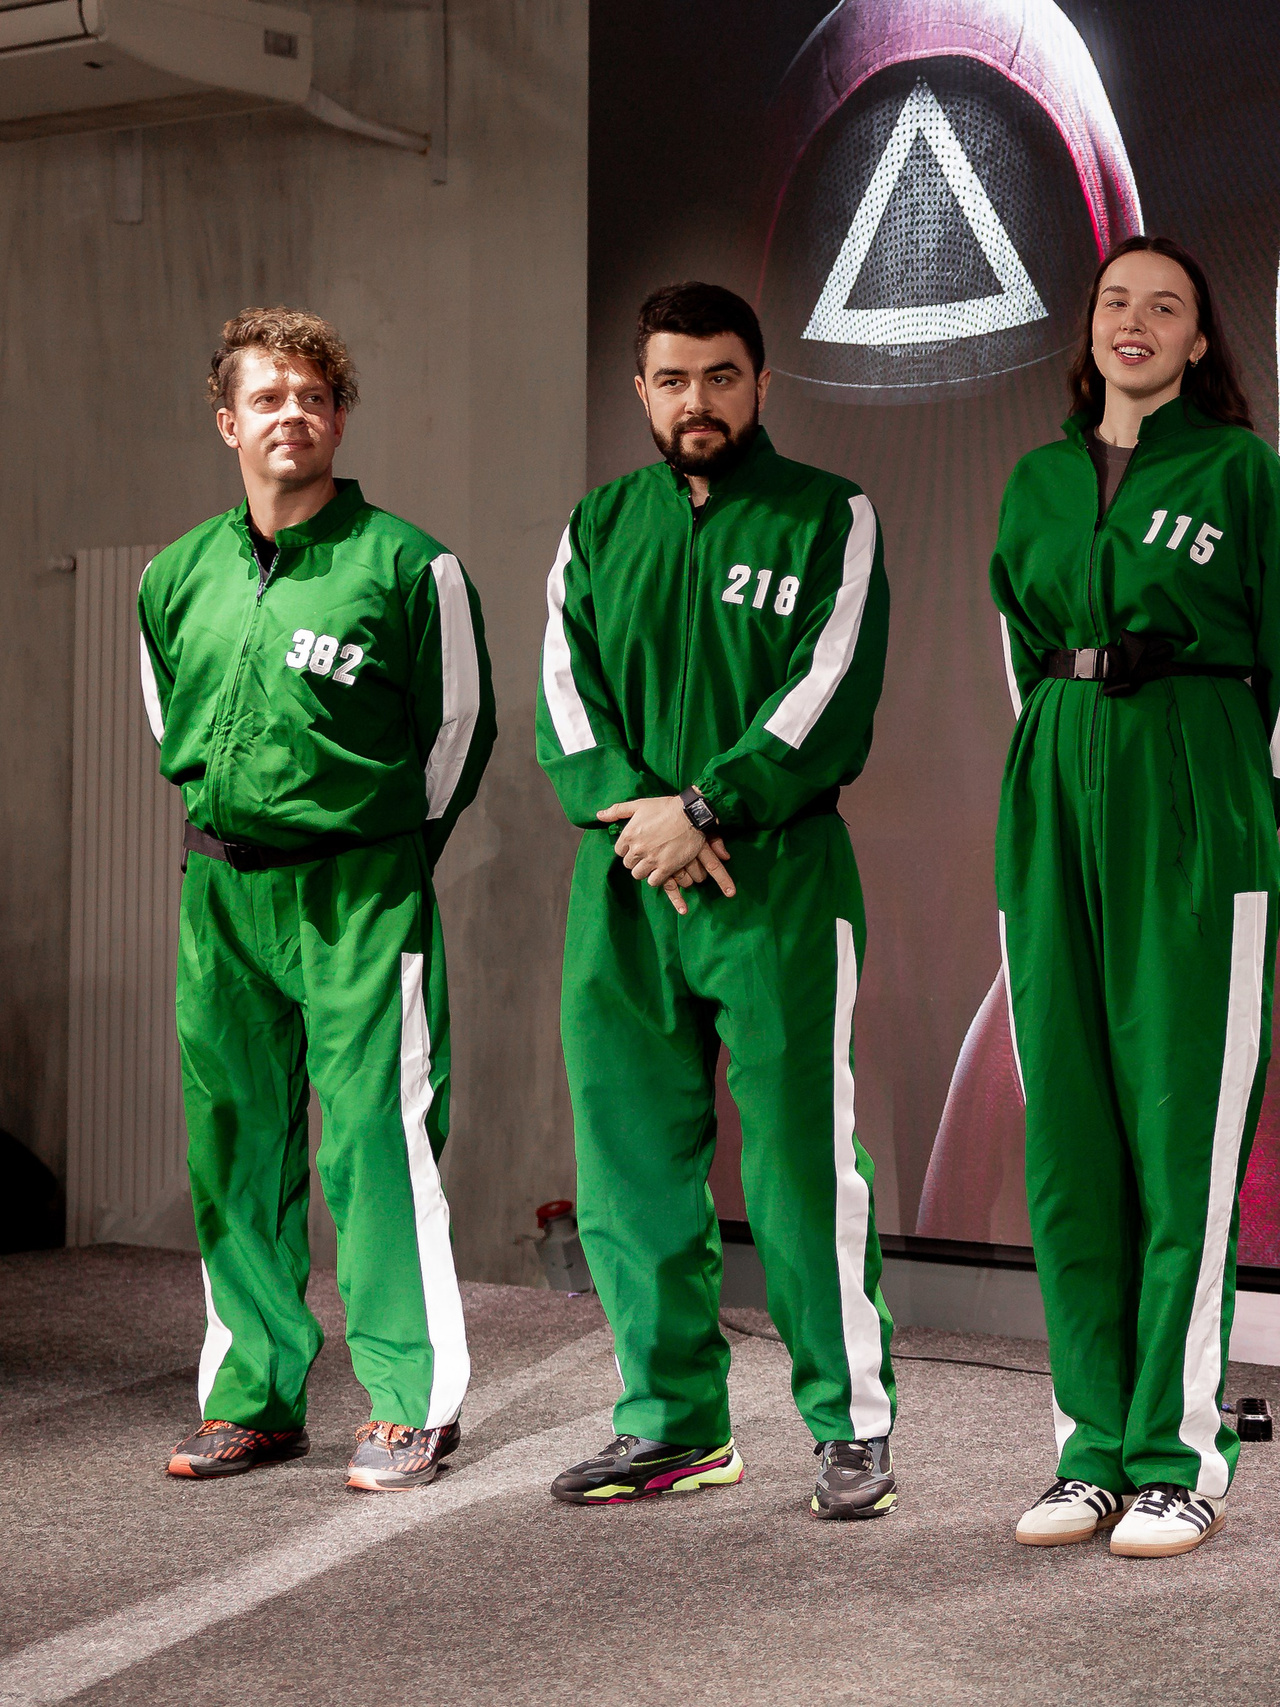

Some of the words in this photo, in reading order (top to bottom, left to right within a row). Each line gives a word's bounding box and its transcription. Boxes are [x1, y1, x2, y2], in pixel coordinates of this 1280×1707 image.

[1142, 509, 1224, 565] 115
[721, 564, 800, 616] 218
[285, 628, 364, 686] 382
